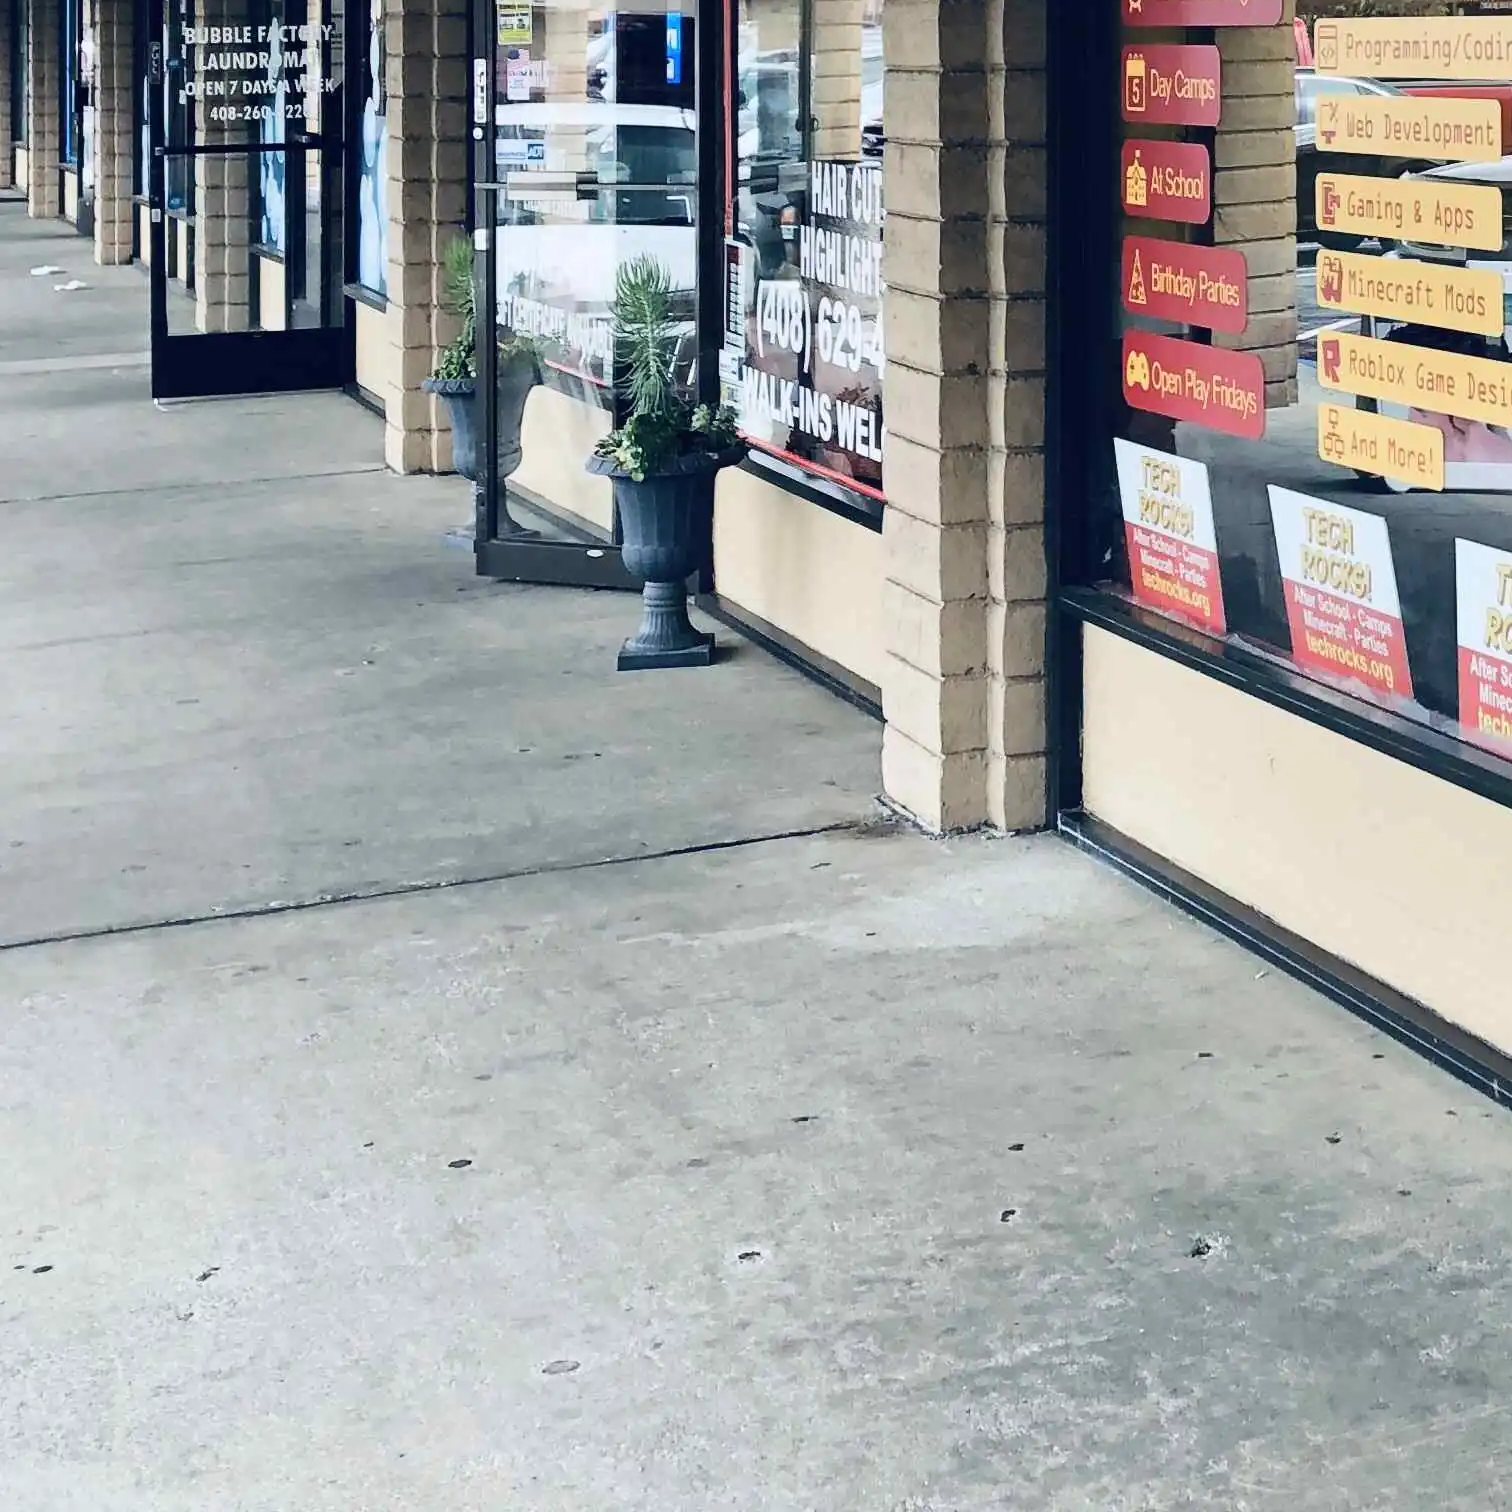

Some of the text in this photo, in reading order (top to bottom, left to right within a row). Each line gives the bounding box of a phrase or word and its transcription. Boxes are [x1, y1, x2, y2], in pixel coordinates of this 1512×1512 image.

[230, 81, 237, 95] 7
[1150, 69, 1215, 106] Day Camps
[1346, 109, 1494, 148] Web Development
[812, 160, 847, 218] HAIR
[1151, 164, 1204, 200] At School
[1347, 192, 1474, 234] Gaming & Apps
[1152, 263, 1240, 307] Birthday Parties
[1348, 270, 1486, 317] Minecraft Mods
[757, 281, 812, 374] (408)
[1152, 361, 1257, 419] Open Play Fridays
[1350, 348, 1405, 385] Roblox
[1416, 363, 1456, 396] Game
[742, 366, 831, 441] WALK-INS
[1351, 431, 1435, 474] And More!
[1305, 629, 1394, 688] techrocks.org
[1470, 656, 1497, 683] After
